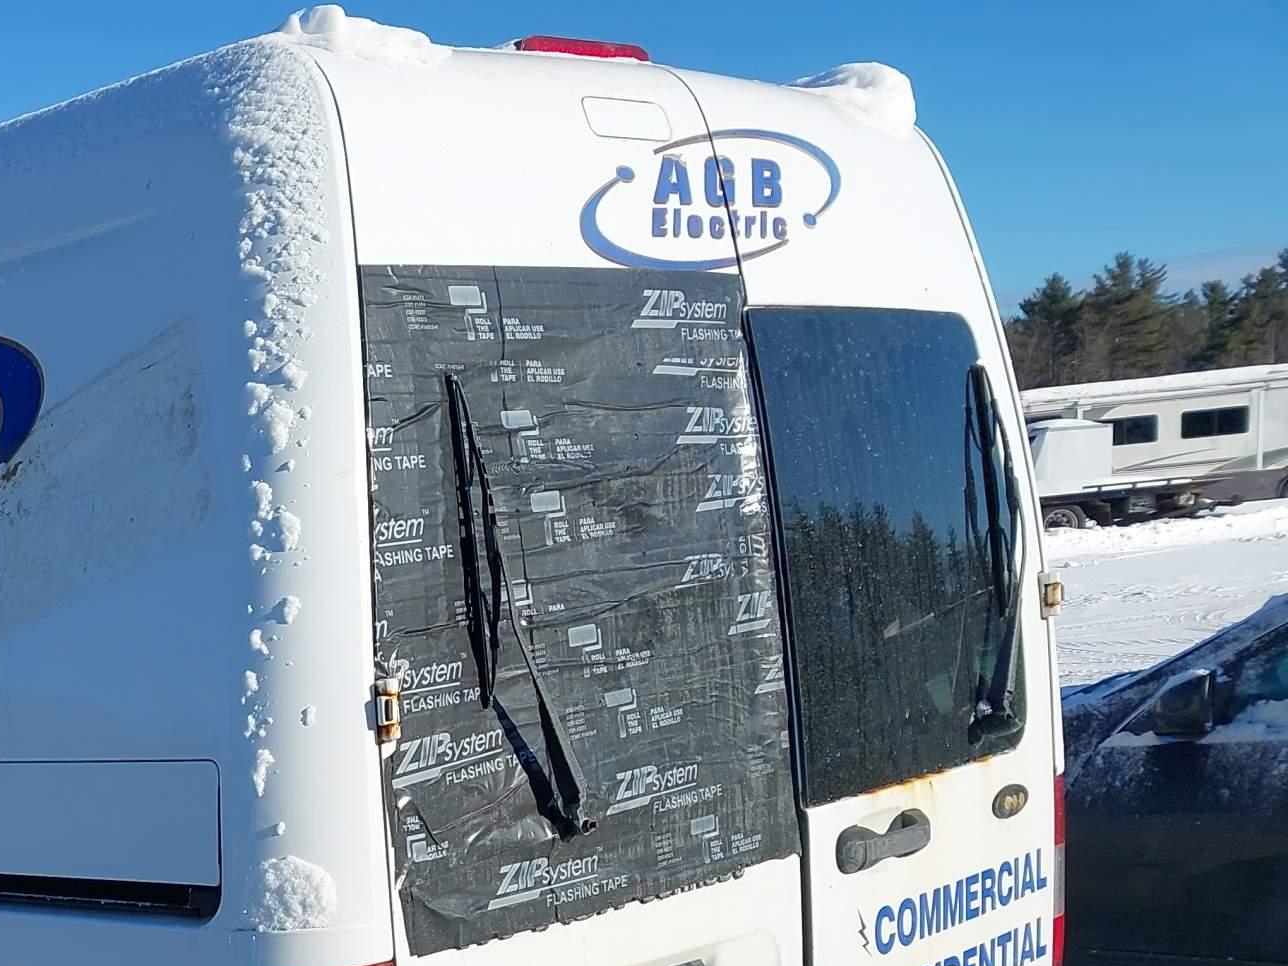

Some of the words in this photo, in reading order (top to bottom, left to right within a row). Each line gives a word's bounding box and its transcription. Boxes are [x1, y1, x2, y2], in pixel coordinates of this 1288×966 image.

[653, 154, 783, 208] AGB
[652, 207, 788, 240] Electric
[681, 328, 728, 340] FLASHING
[527, 367, 552, 375] APLICAR
[536, 375, 562, 383] RODILLO
[394, 455, 426, 469] TAPE
[425, 544, 454, 560] TAPE
[548, 604, 565, 612] PARA
[616, 648, 630, 656] PARA
[403, 691, 460, 714] FLASHING
[628, 726, 643, 734] TAPE
[446, 759, 505, 786] FLASHING
[653, 790, 698, 813] FLASHING
[699, 784, 723, 799] TAPE
[710, 839, 722, 847] ROLL
[712, 853, 724, 861] TAPE
[546, 883, 600, 907] FLASHING
[602, 875, 629, 893] TAPE
[874, 848, 1047, 955] COMMERCIAL
